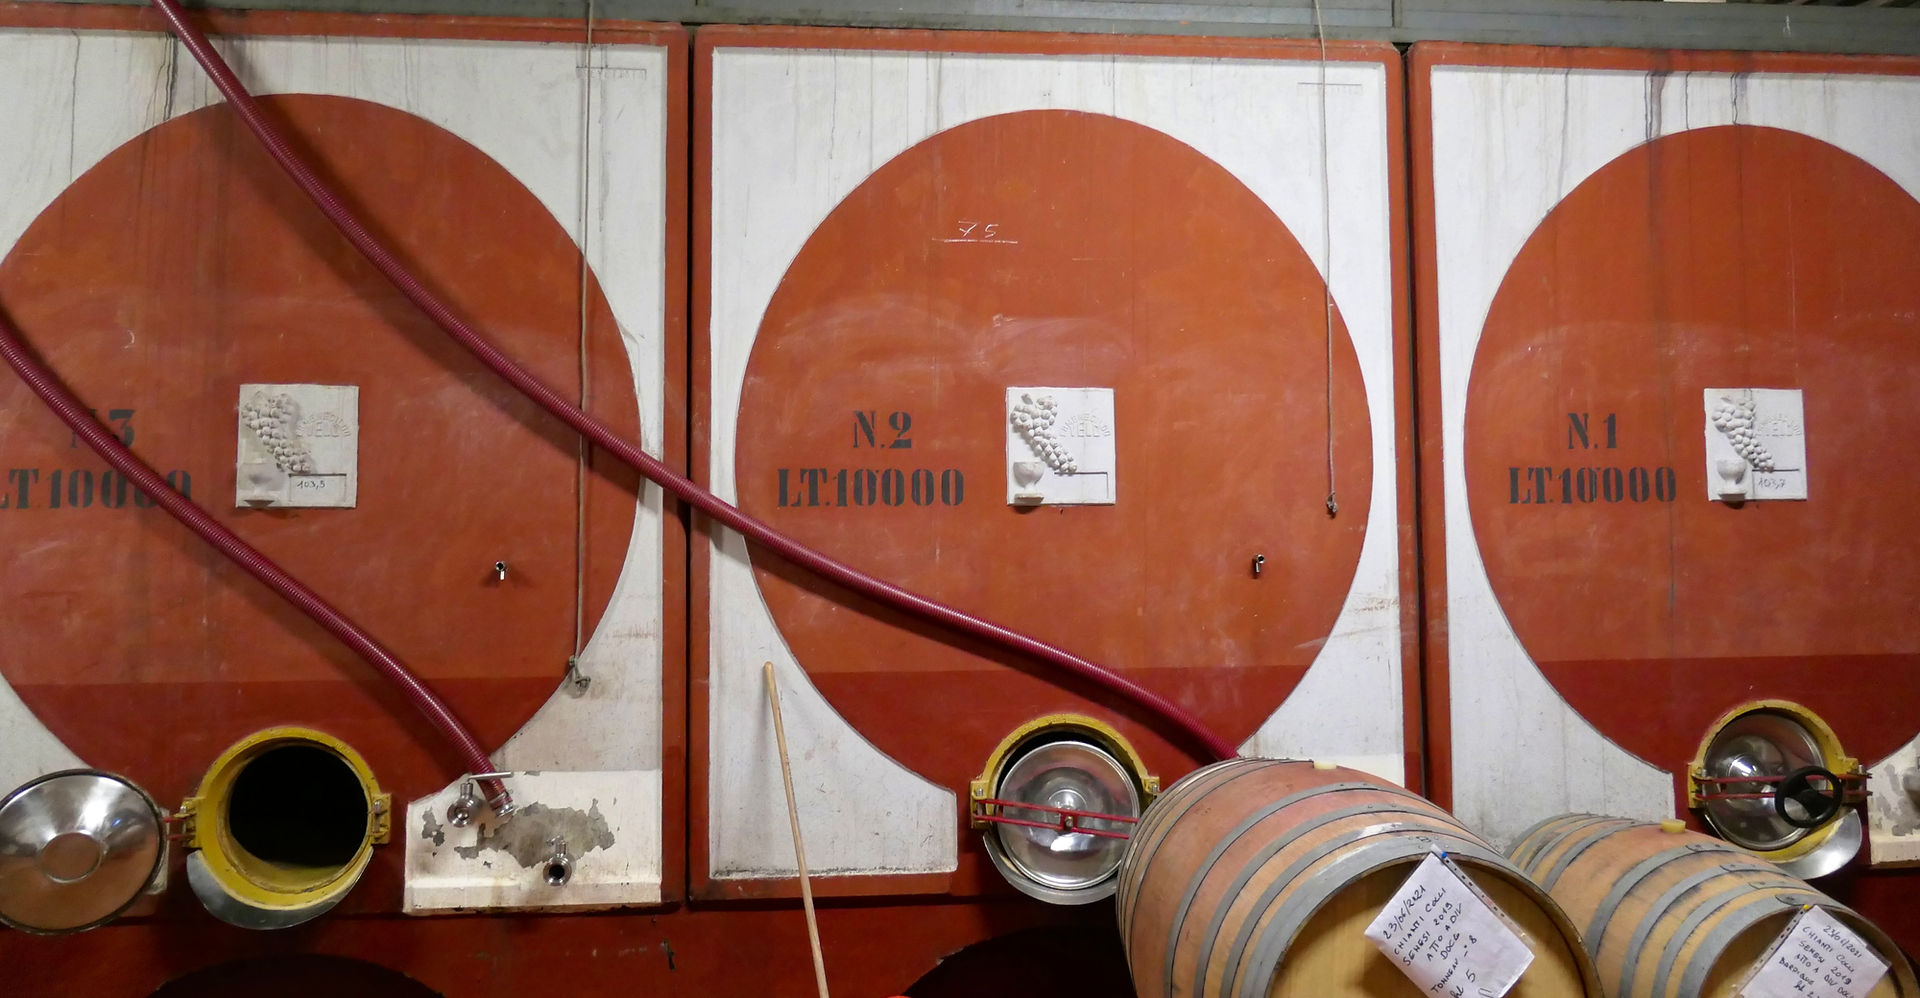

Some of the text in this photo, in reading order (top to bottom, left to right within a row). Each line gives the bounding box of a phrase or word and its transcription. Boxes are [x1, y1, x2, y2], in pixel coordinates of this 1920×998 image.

[957, 220, 999, 239] 75
[853, 411, 912, 449] N.2
[1567, 412, 1617, 449] N.1
[1434, 902, 1453, 926] 2019
[1394, 916, 1424, 955] CHIANTI
[1440, 933, 1460, 960] DOCG
[1803, 926, 1833, 952] CHIANTI
[1466, 968, 1476, 982] 5
[1831, 966, 1852, 985] 2019
